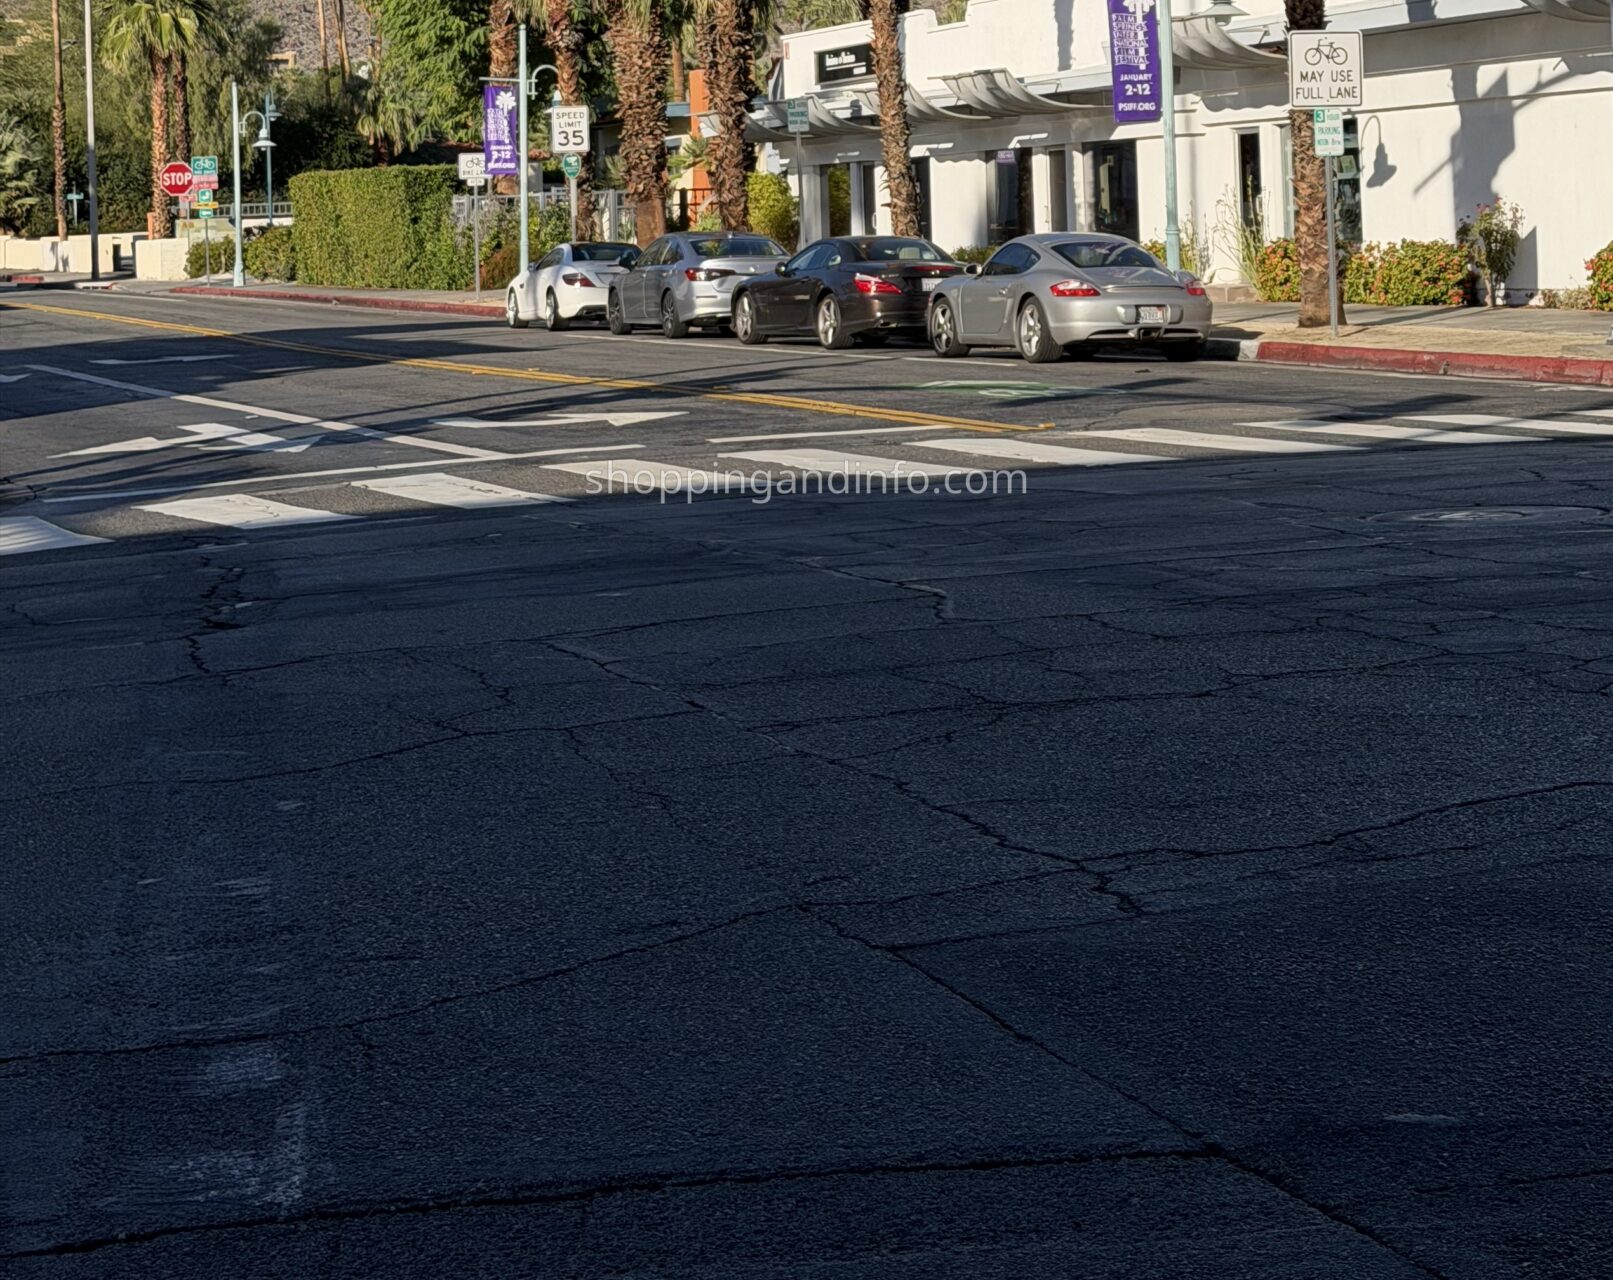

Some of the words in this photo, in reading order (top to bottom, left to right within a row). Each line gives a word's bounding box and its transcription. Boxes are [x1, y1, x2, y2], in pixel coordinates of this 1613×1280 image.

[1112, 14, 1135, 23] PALM
[1113, 22, 1149, 31] SPRINGS
[1114, 39, 1149, 48] NATIONAL
[1114, 48, 1136, 56] FILM
[1115, 56, 1150, 65] FESTIVAL
[1300, 71, 1324, 82] MAY
[1331, 70, 1353, 82] USE
[1125, 84, 1151, 95] 2-12
[1296, 88, 1323, 99] FULL
[1330, 87, 1358, 98] LANE
[1118, 102, 1156, 111] PSIFF.ORG
[1317, 110, 1324, 122] 3
[558, 130, 584, 146] 35
[163, 172, 192, 186] STOP
